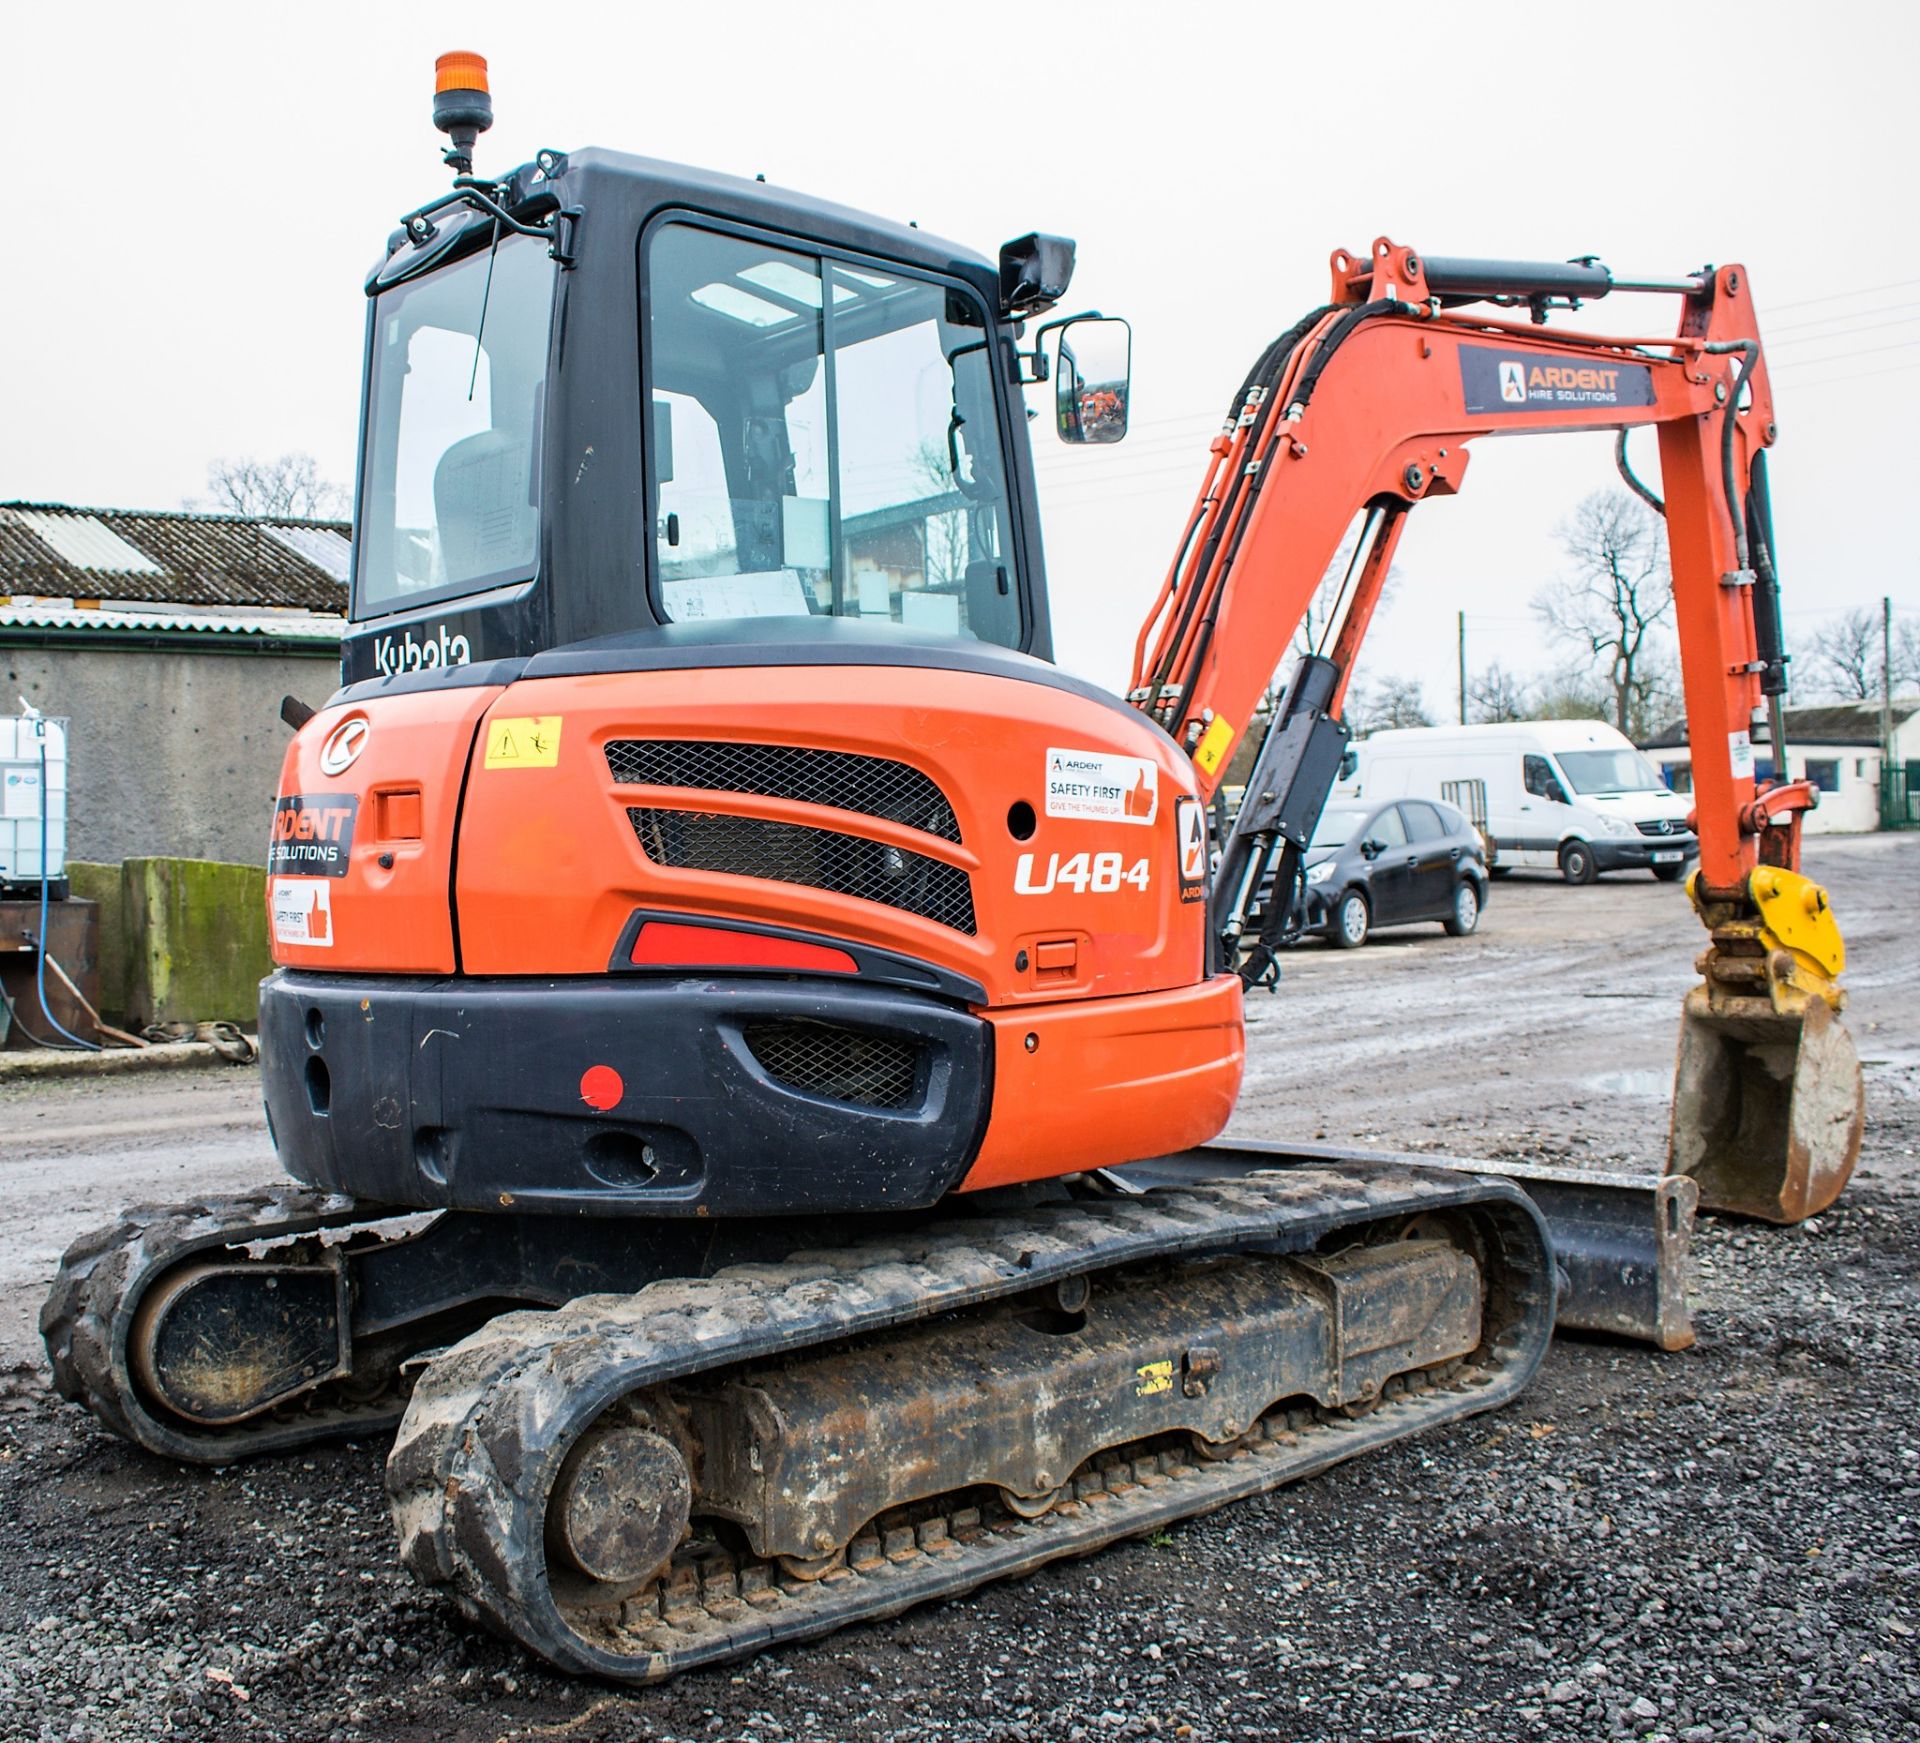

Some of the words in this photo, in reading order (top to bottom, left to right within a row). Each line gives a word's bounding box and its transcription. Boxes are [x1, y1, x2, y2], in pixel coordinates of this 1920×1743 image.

[1529, 366, 1618, 390] ARDENT
[1529, 390, 1553, 400] HIRE
[1557, 390, 1617, 402] SOLUTIONS
[374, 624, 470, 676] Kubota
[1066, 760, 1103, 771] ARDENT
[1051, 782, 1091, 797] SAFETY
[1093, 786, 1121, 800] FIRST
[276, 808, 352, 841] RDENT
[276, 846, 338, 861] SOLUTIONS
